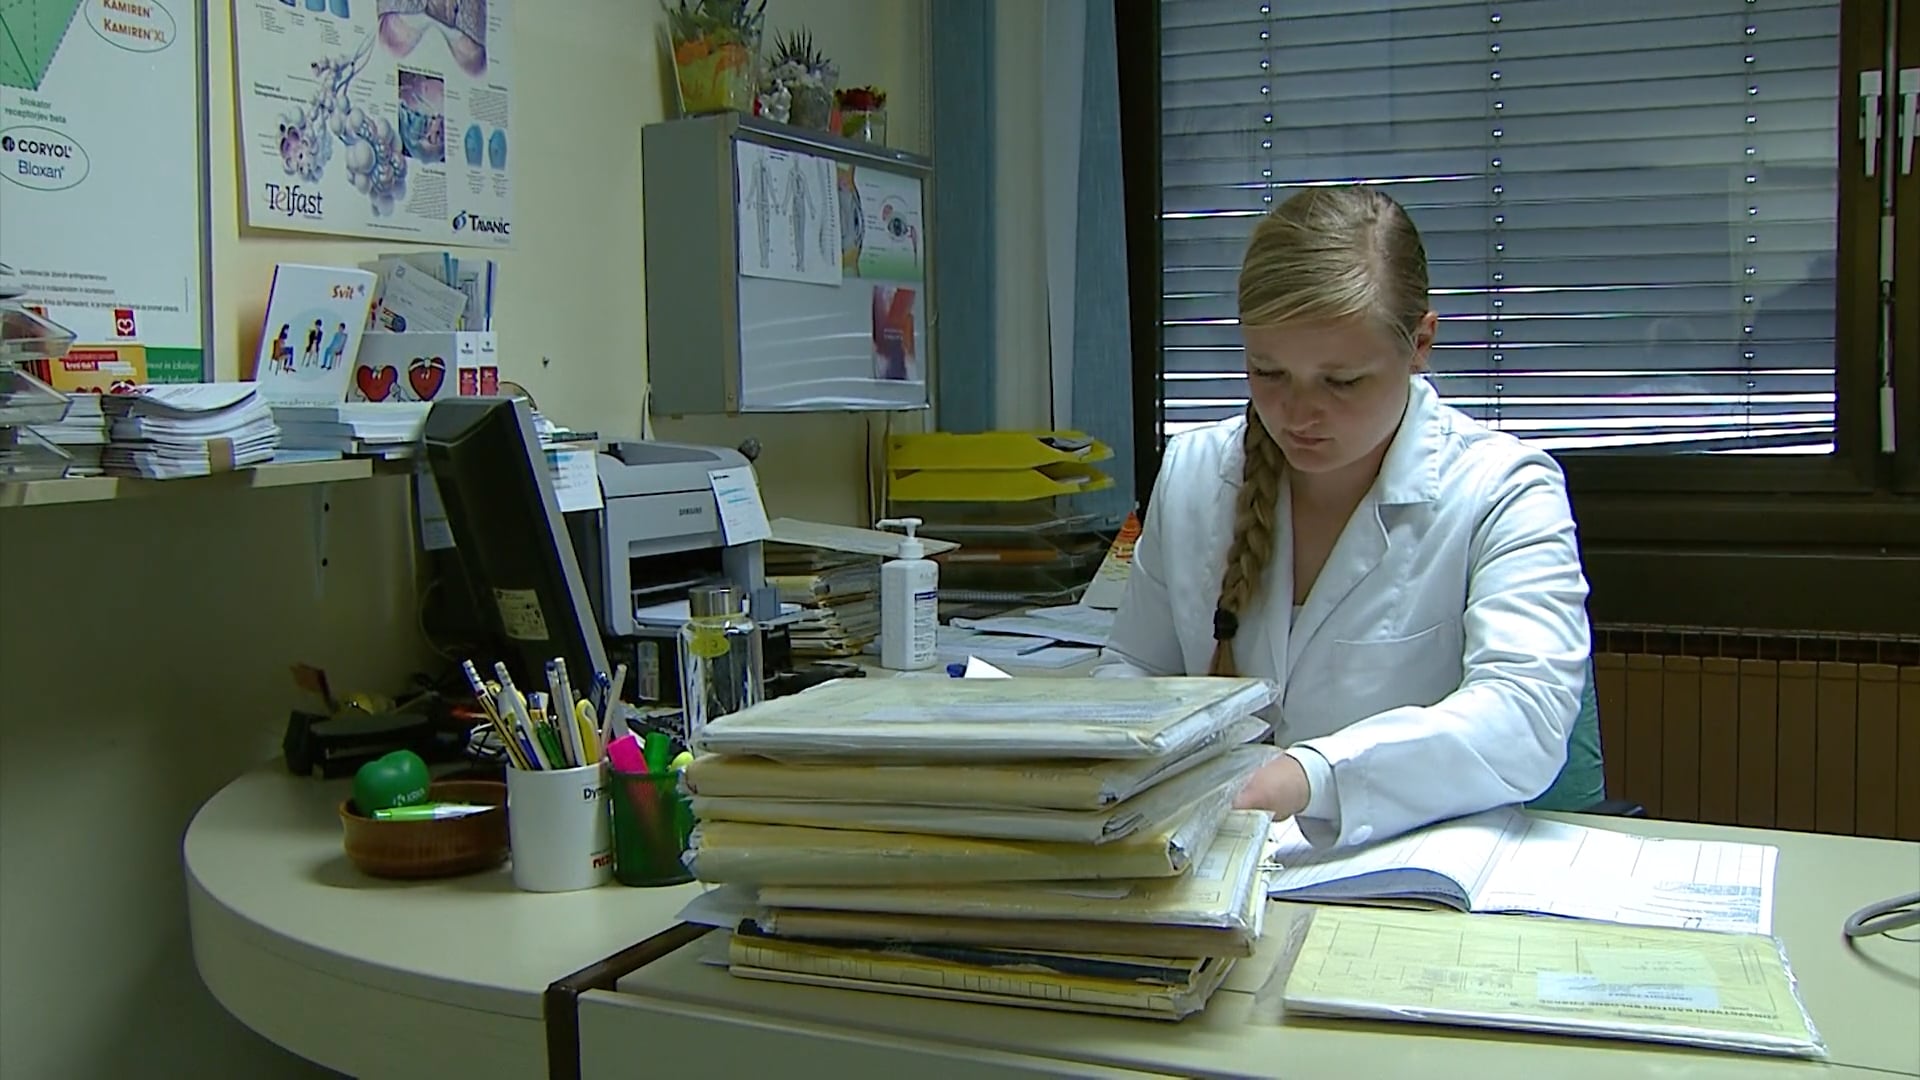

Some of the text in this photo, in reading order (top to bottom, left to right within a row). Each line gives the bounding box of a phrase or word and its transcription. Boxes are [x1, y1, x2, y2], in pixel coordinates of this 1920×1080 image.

[103, 0, 151, 18] KAMIREN
[103, 18, 151, 40] KAMIREN
[265, 183, 323, 217] Telfast
[331, 284, 354, 300] Svit
